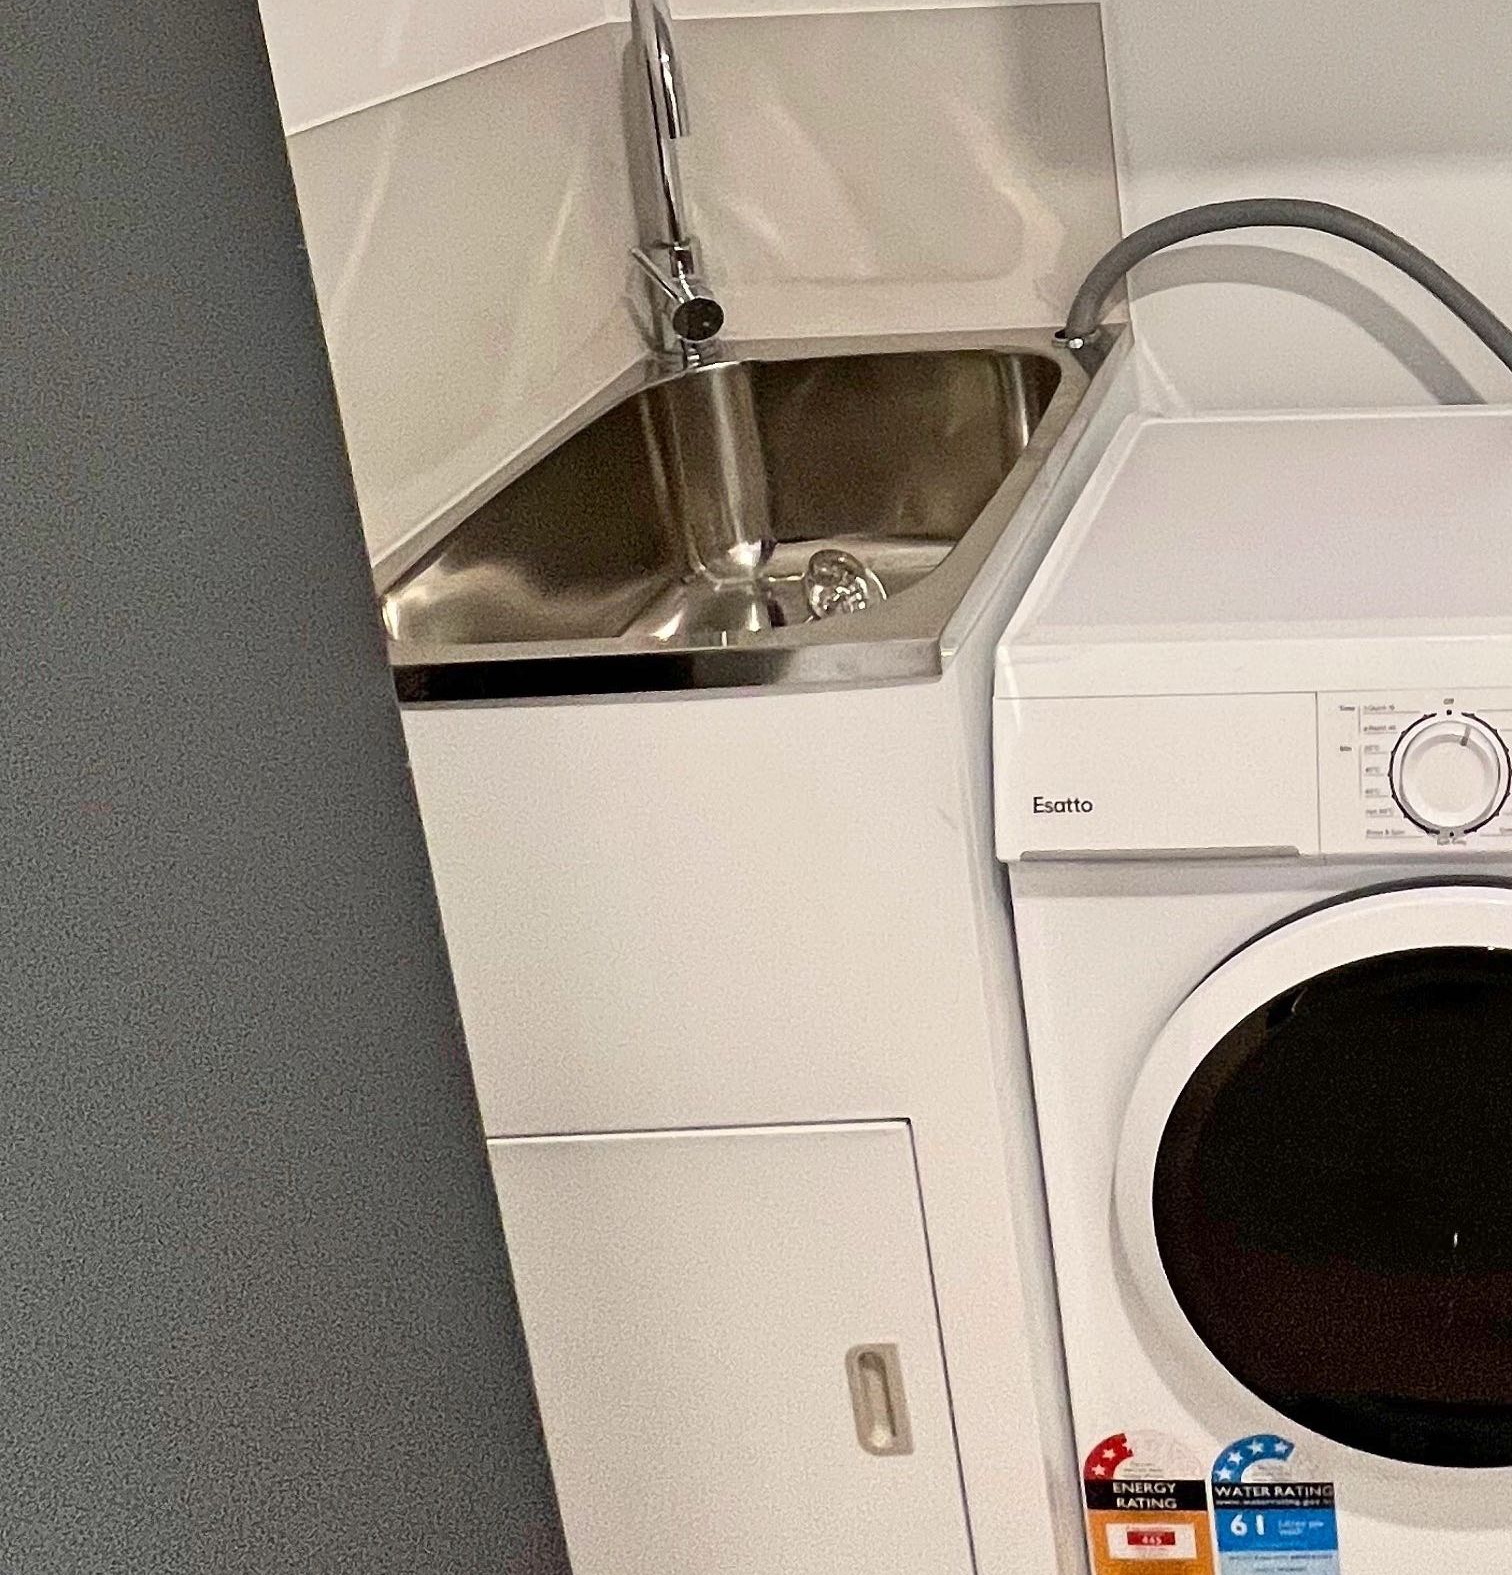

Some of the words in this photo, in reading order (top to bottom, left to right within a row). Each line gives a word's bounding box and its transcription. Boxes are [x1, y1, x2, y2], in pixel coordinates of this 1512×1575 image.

[1033, 796, 1093, 813] Esatto
[1112, 1482, 1176, 1494] ENERGY
[1215, 1486, 1271, 1497] WATER
[1274, 1485, 1334, 1497] RATING
[1116, 1497, 1177, 1509] RATING
[1230, 1513, 1265, 1536] 61
